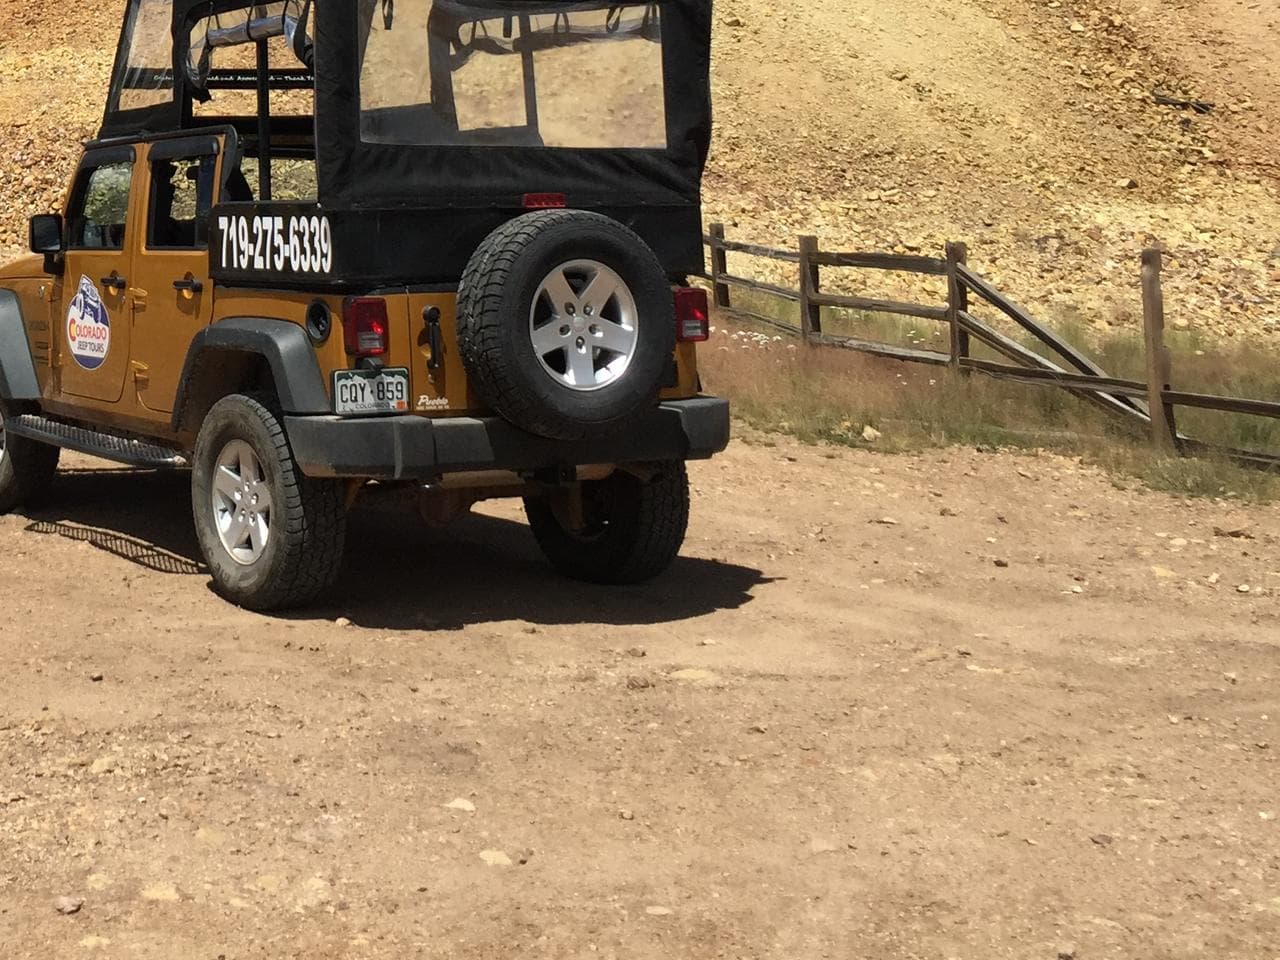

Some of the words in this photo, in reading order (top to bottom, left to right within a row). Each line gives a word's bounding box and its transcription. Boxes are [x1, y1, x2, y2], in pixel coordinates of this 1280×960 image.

[218, 215, 332, 273] 719-275-6339
[69, 318, 107, 341] COLORADO
[88, 342, 105, 353] TOURS
[417, 394, 449, 406] Pueblo
